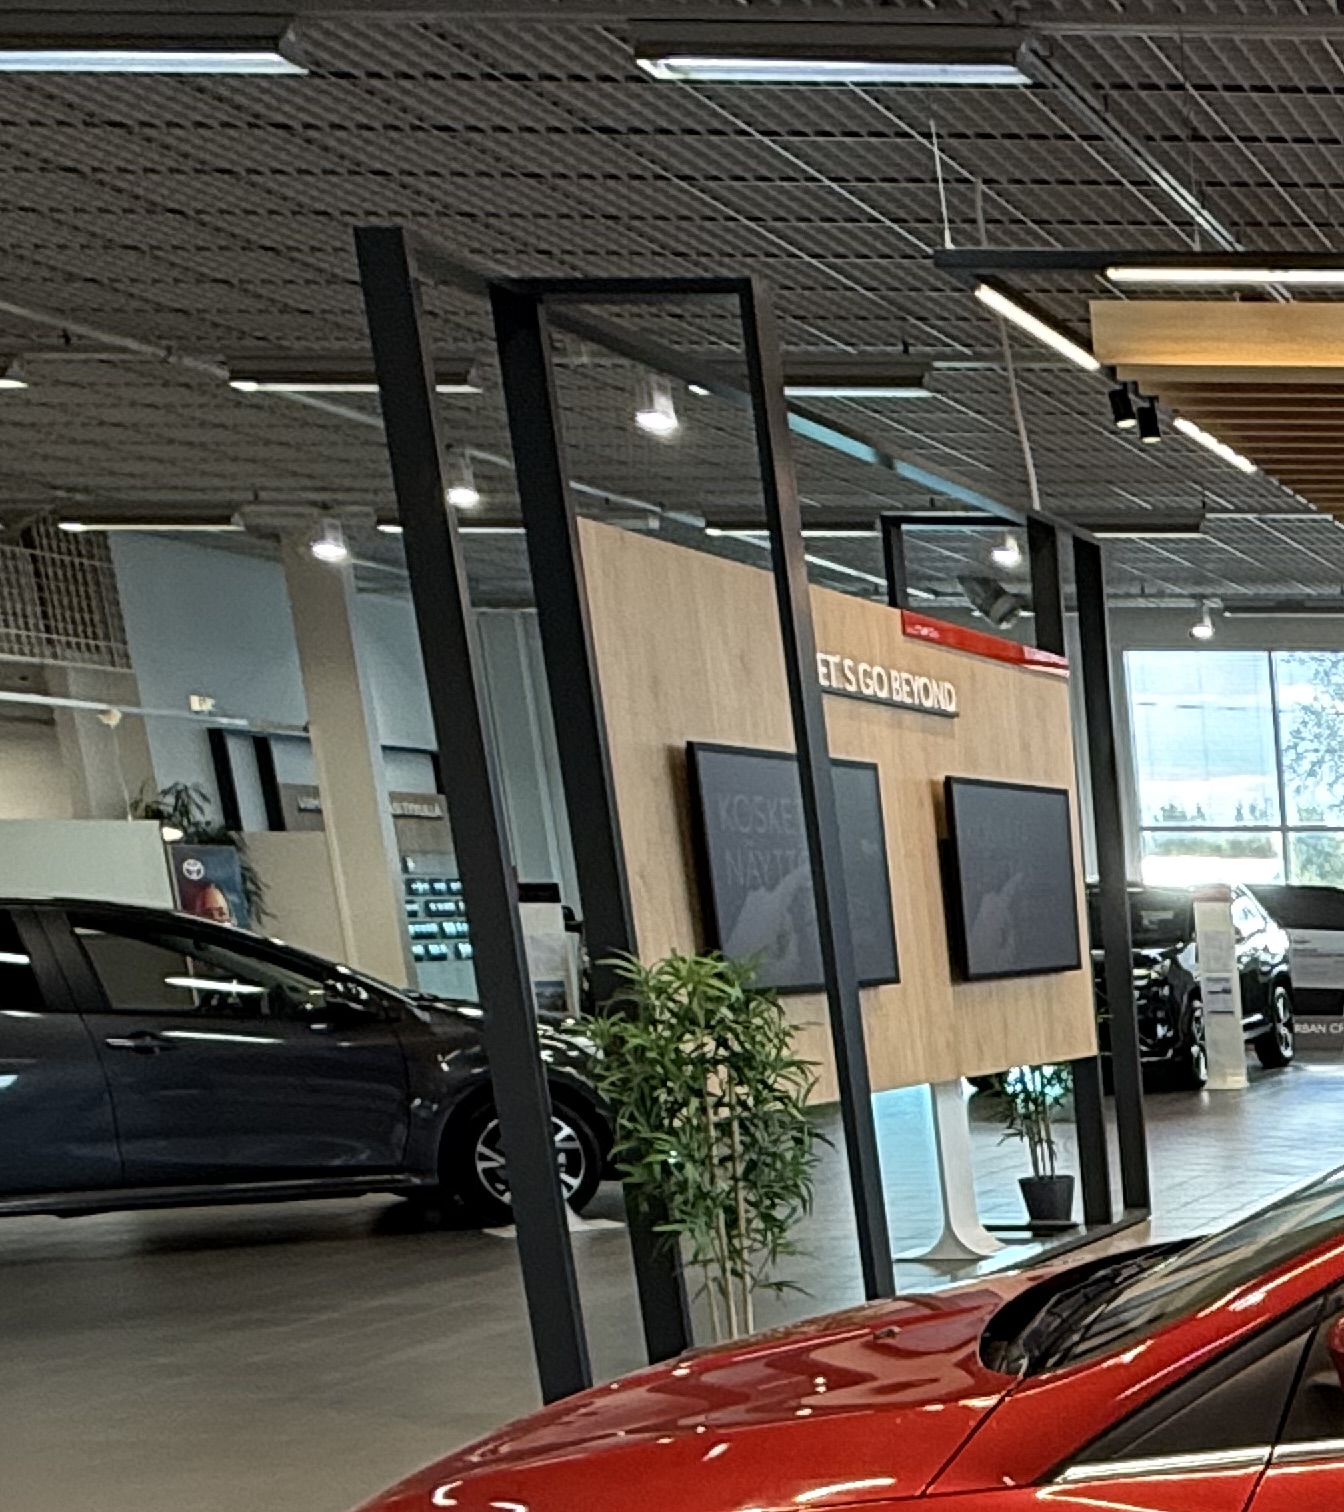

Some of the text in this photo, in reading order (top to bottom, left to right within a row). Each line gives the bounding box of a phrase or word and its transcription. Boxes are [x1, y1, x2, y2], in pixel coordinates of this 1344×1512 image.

[815, 652, 958, 712] ET'S GO BEYOND
[717, 791, 801, 834] KOSKE
